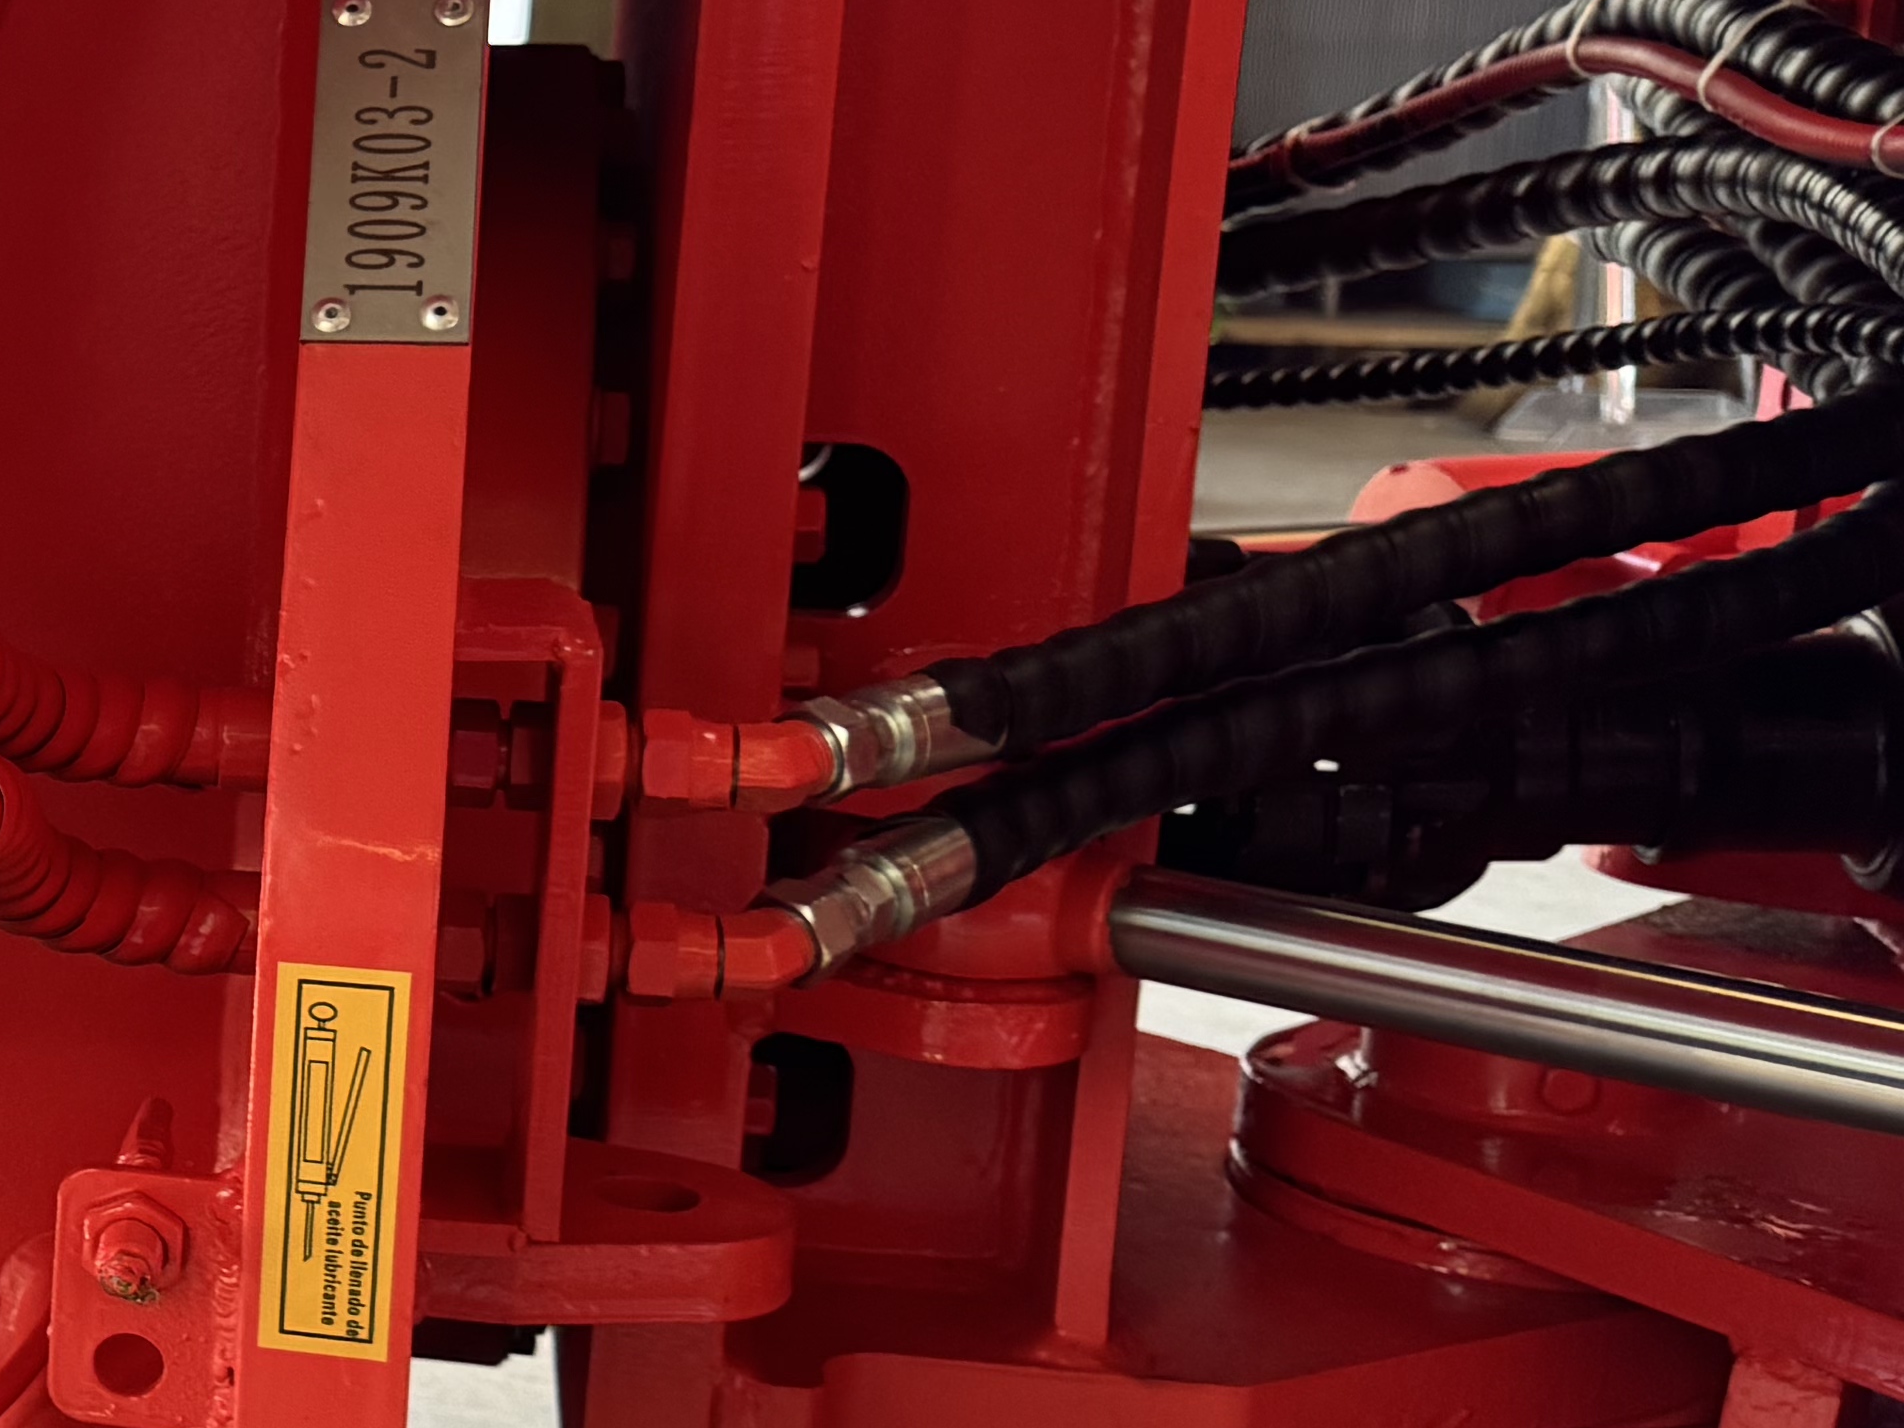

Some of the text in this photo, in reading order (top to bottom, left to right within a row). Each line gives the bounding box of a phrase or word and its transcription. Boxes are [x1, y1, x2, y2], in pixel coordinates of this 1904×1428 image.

[343, 48, 437, 297] 1909K03-2
[320, 1200, 345, 1326] aceite lubricante
[345, 1190, 373, 1337] Punto de llenado de
